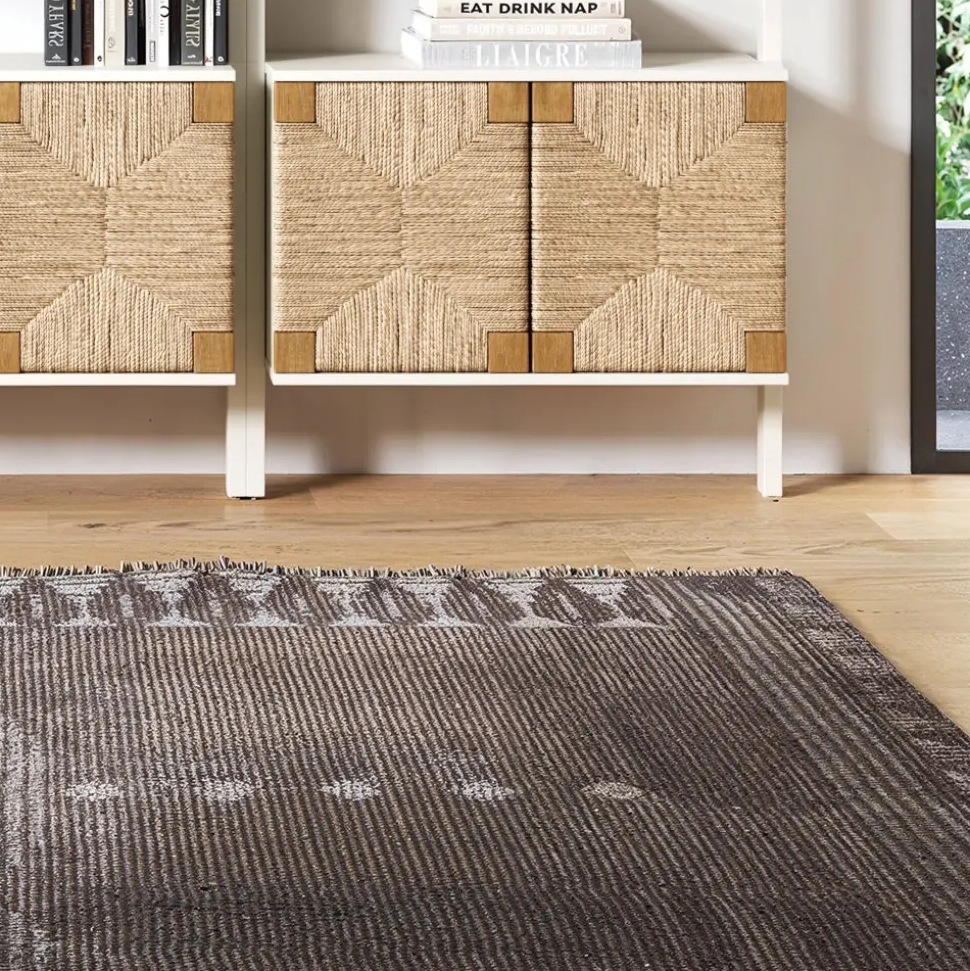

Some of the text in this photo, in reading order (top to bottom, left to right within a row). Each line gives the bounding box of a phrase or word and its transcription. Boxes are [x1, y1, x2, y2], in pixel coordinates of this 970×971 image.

[460, 2, 598, 14] EAT DRINK NAP
[476, 43, 588, 67] LIAIGRE
